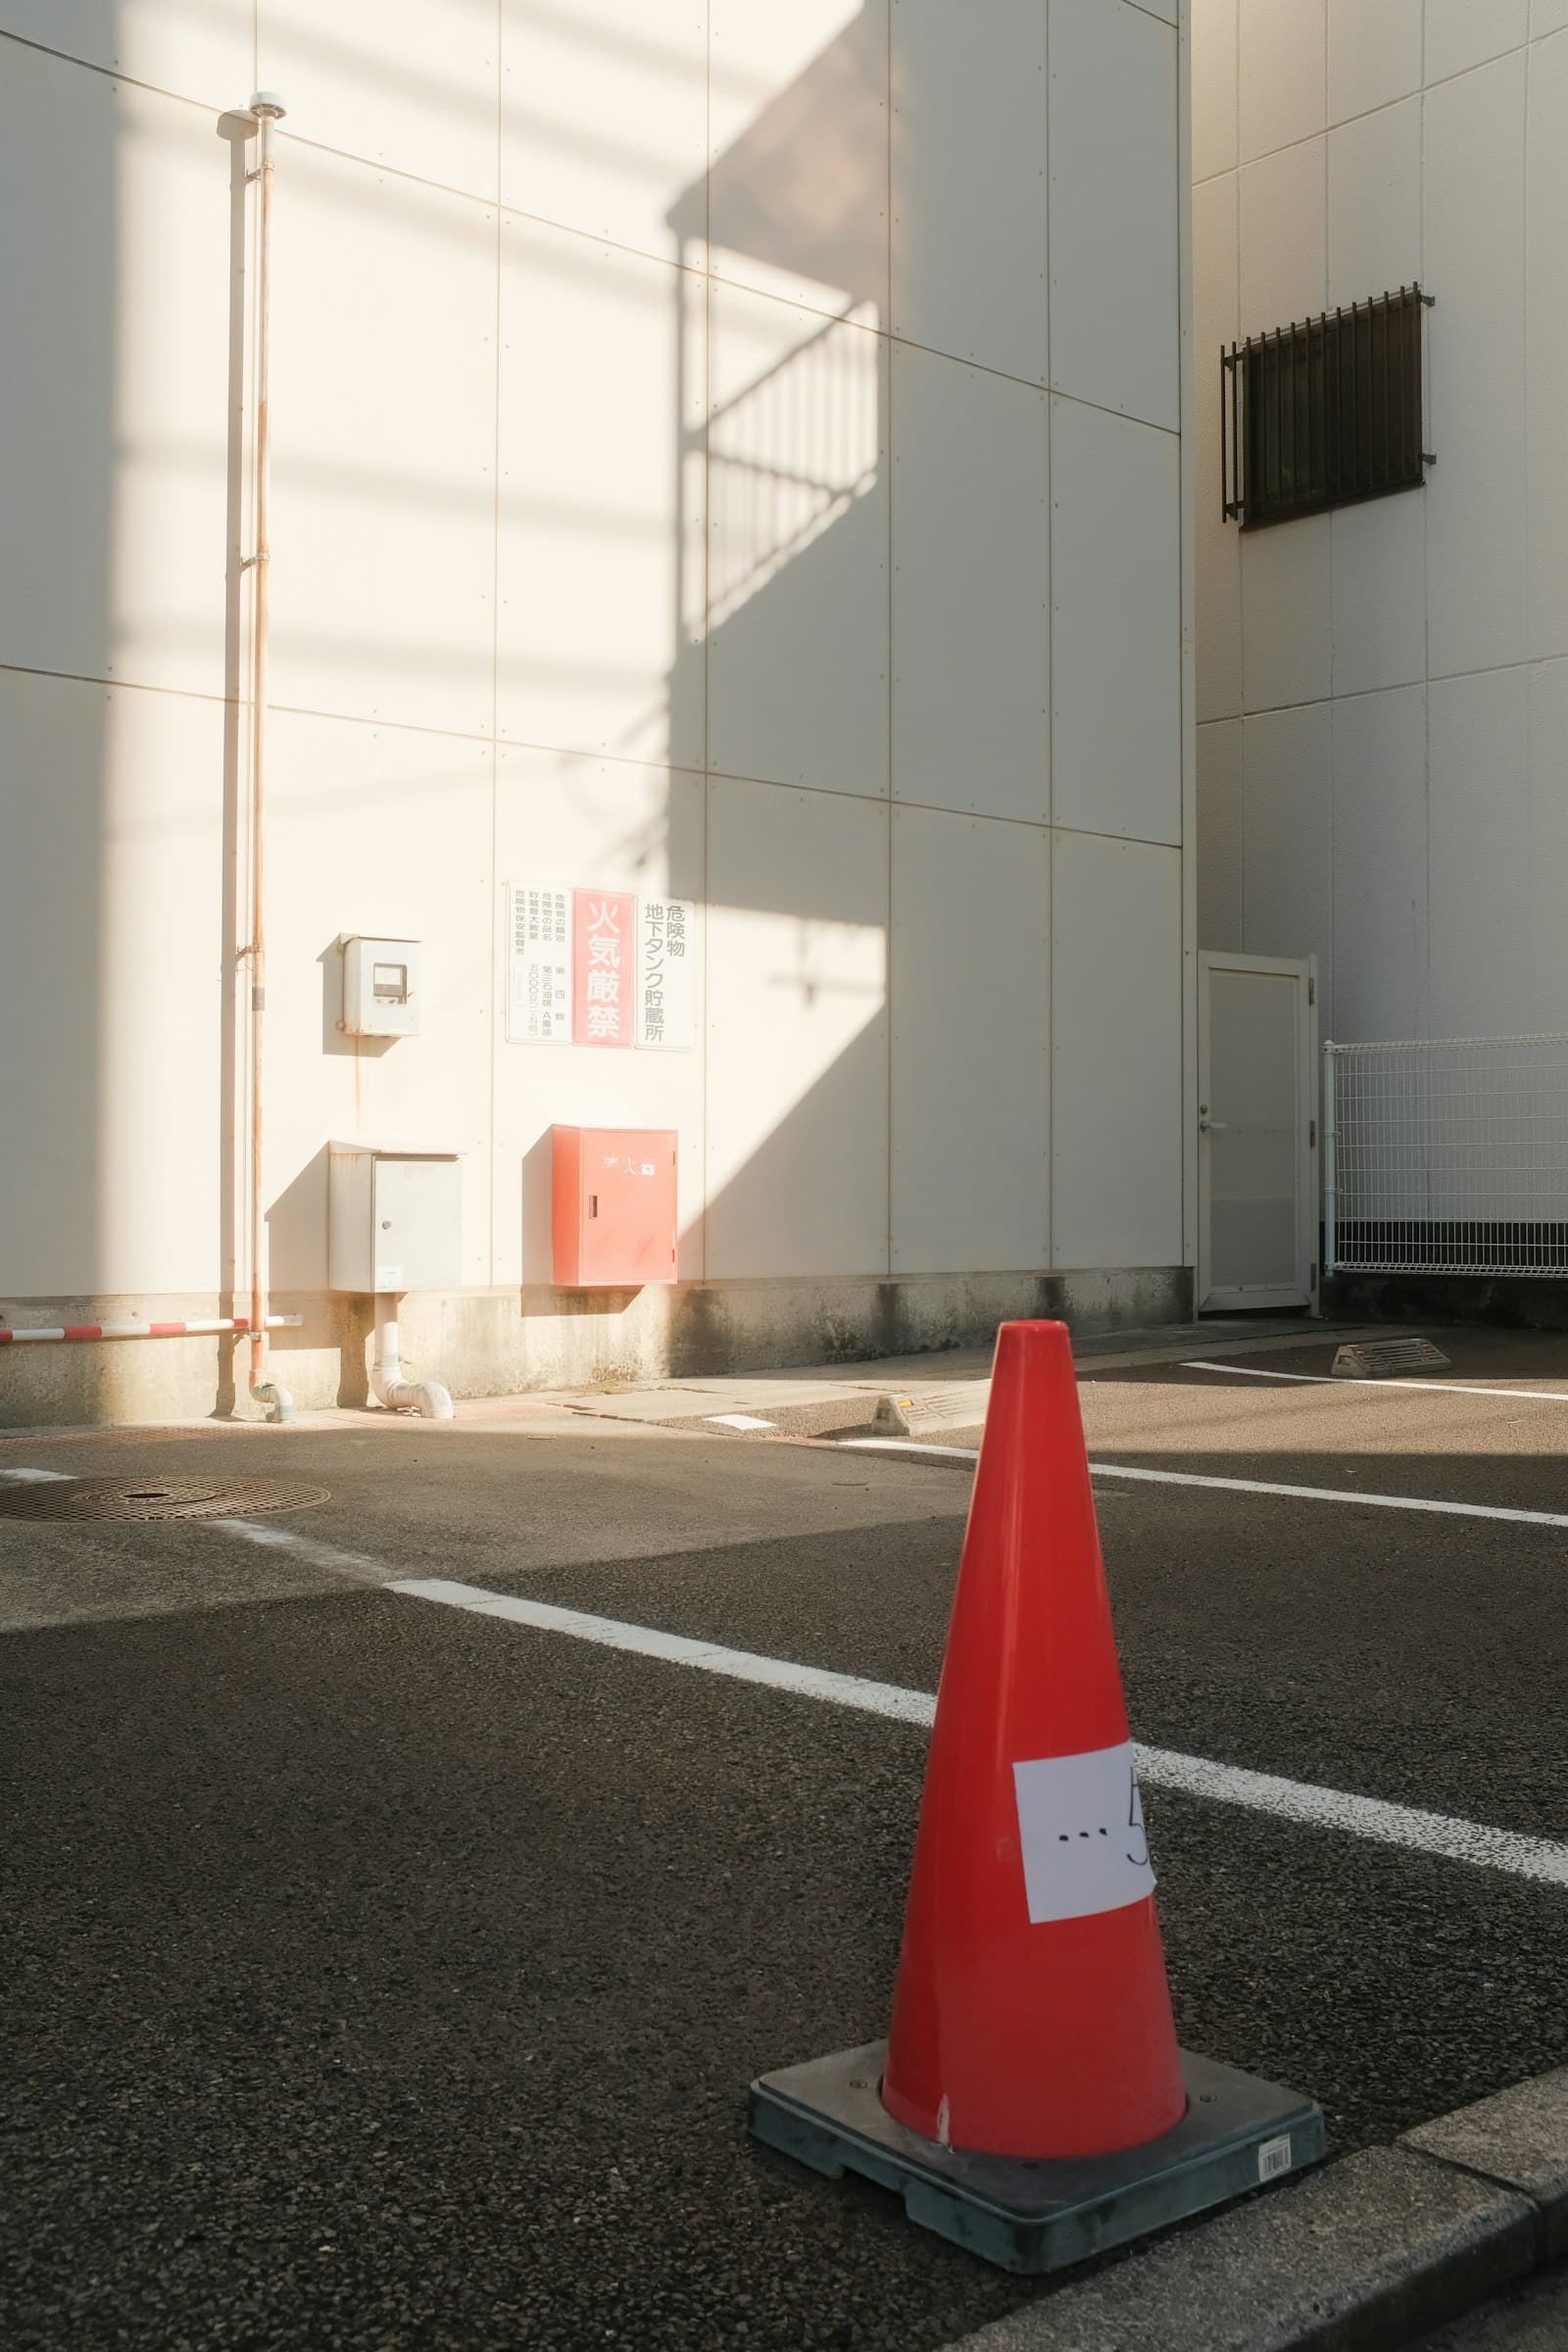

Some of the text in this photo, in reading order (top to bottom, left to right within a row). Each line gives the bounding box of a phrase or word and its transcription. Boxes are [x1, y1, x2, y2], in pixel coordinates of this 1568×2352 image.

[587, 901, 620, 1039] 火気厳禁
[644, 904, 665, 1043] 地下タンク貯蔵所
[666, 905, 685, 957] 危険物
